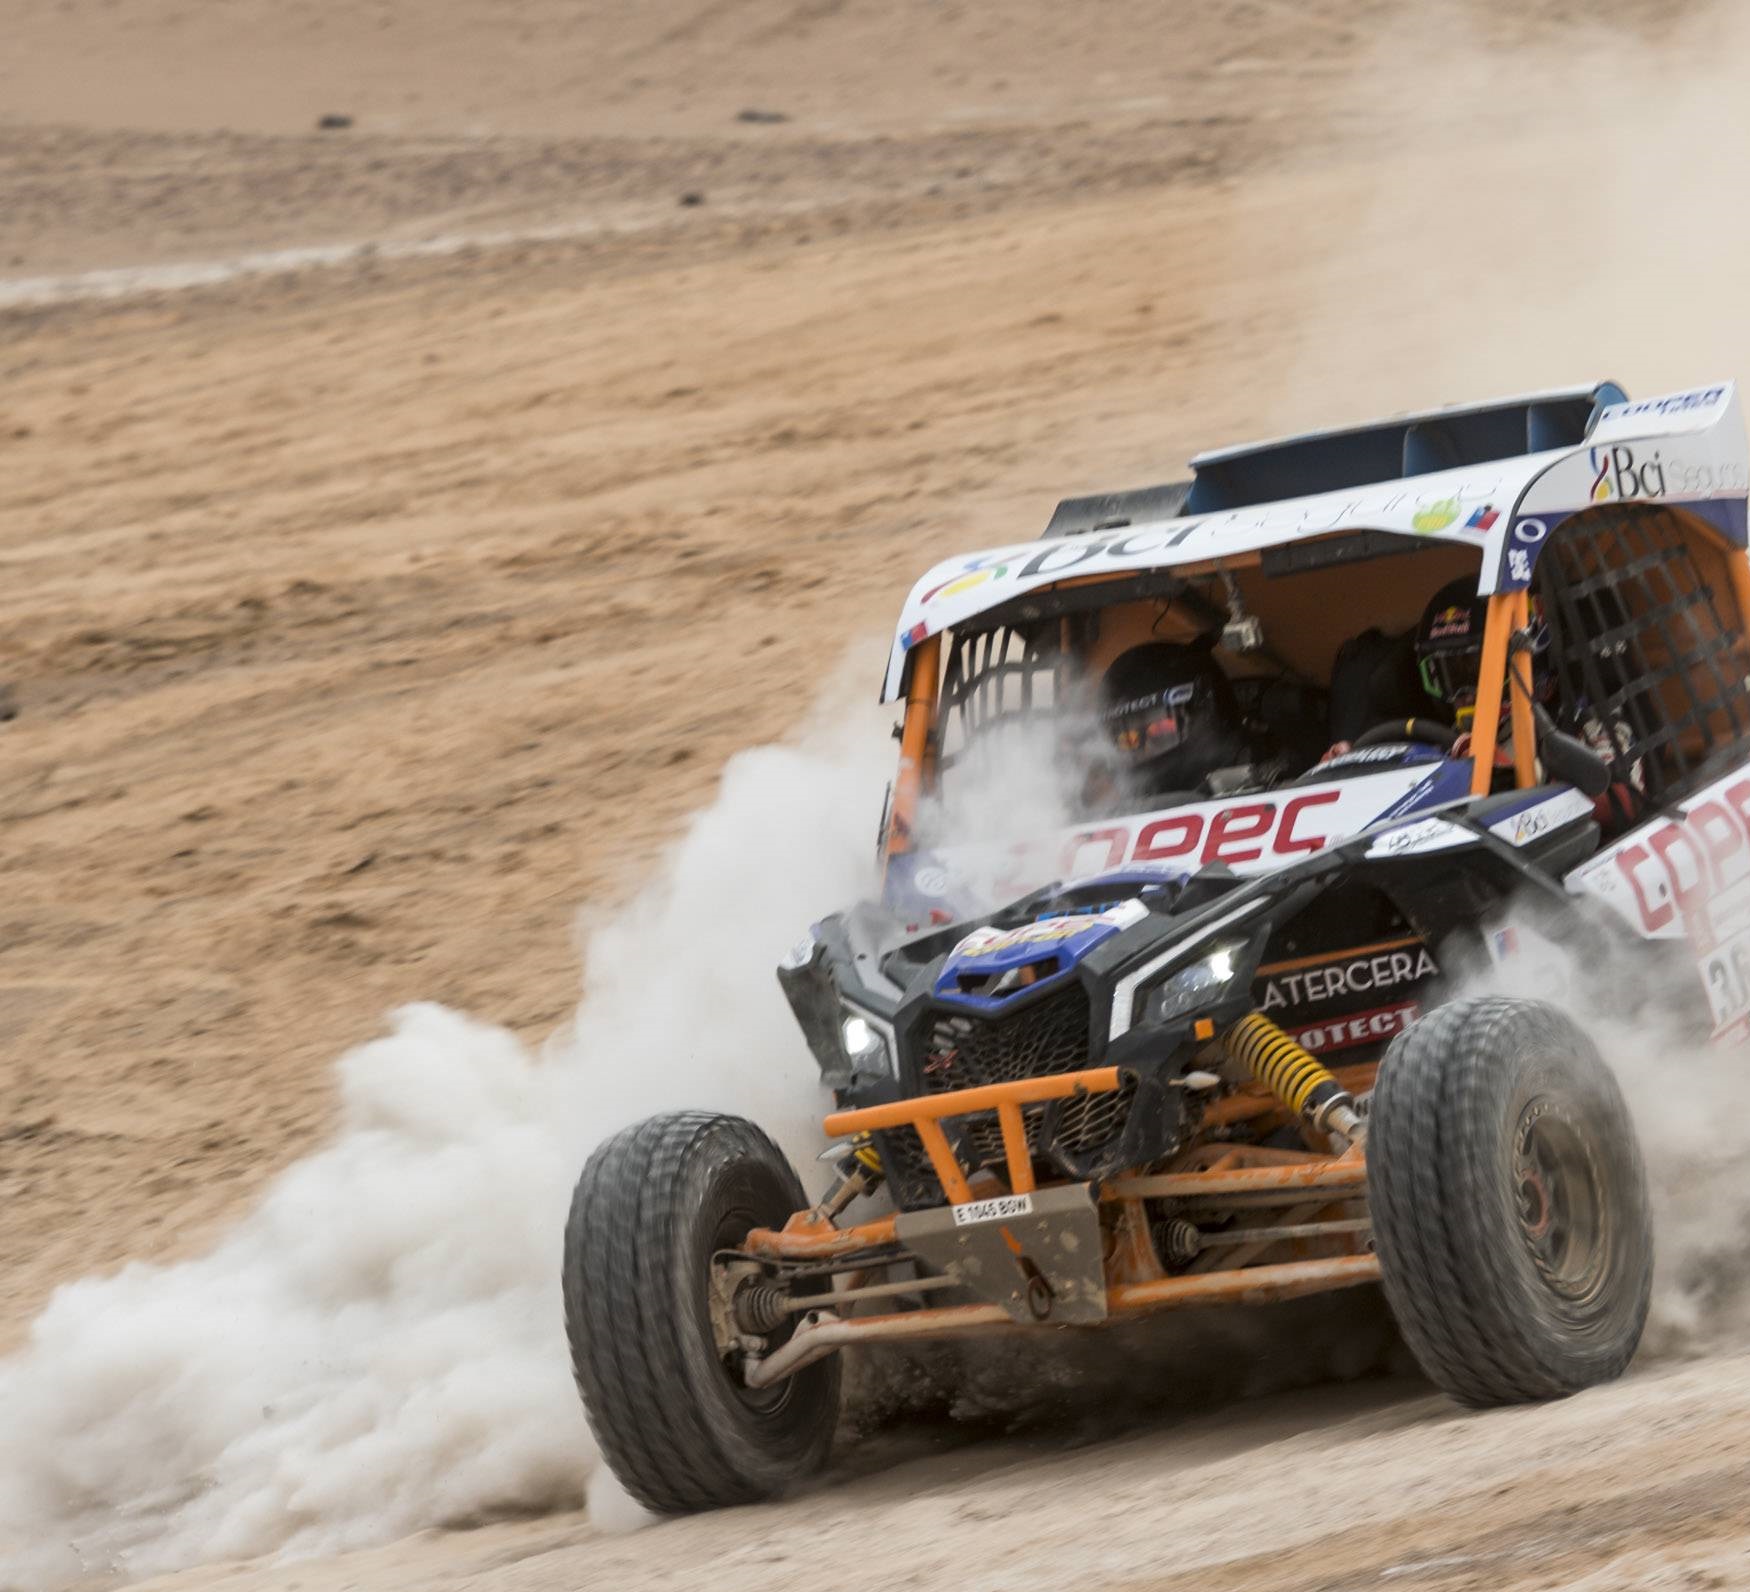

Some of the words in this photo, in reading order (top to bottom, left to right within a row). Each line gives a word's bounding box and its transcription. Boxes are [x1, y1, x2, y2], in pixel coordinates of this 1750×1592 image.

[1612, 446, 1666, 499] Bci
[1254, 948, 1439, 1013] ATERCERA
[1294, 1004, 1418, 1050] OTECT
